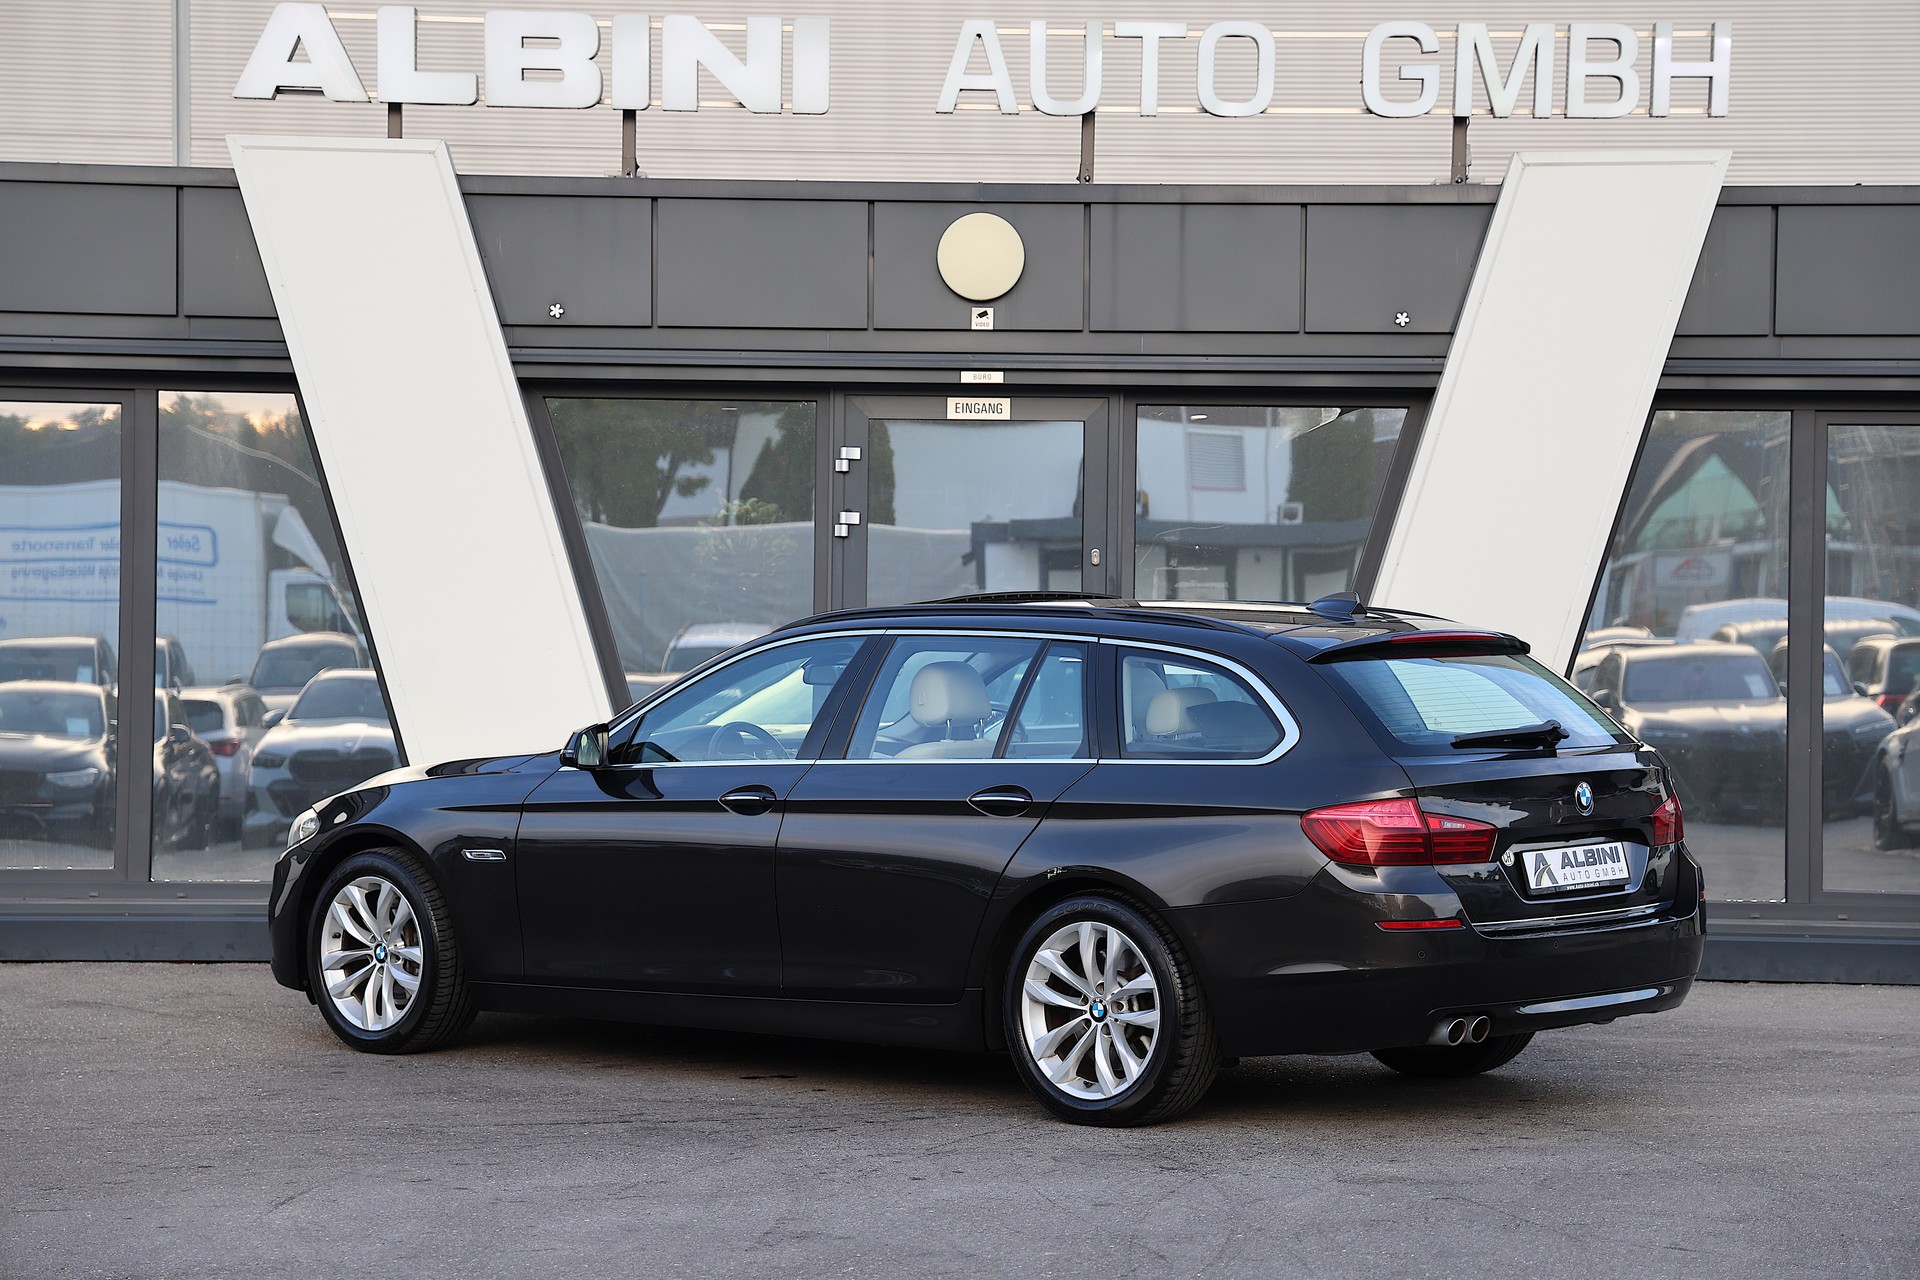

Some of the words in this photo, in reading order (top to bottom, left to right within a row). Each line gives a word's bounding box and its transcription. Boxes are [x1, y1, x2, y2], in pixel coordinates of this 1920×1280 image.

[232, 2, 831, 115] ALBINI
[935, 19, 1277, 118] AUTO
[1360, 20, 1733, 119] GMBH
[954, 402, 1003, 415] EINGANG
[1560, 845, 1621, 870] ALBINI
[1563, 869, 1591, 882] AUTO
[1594, 865, 1624, 878] GMBH
